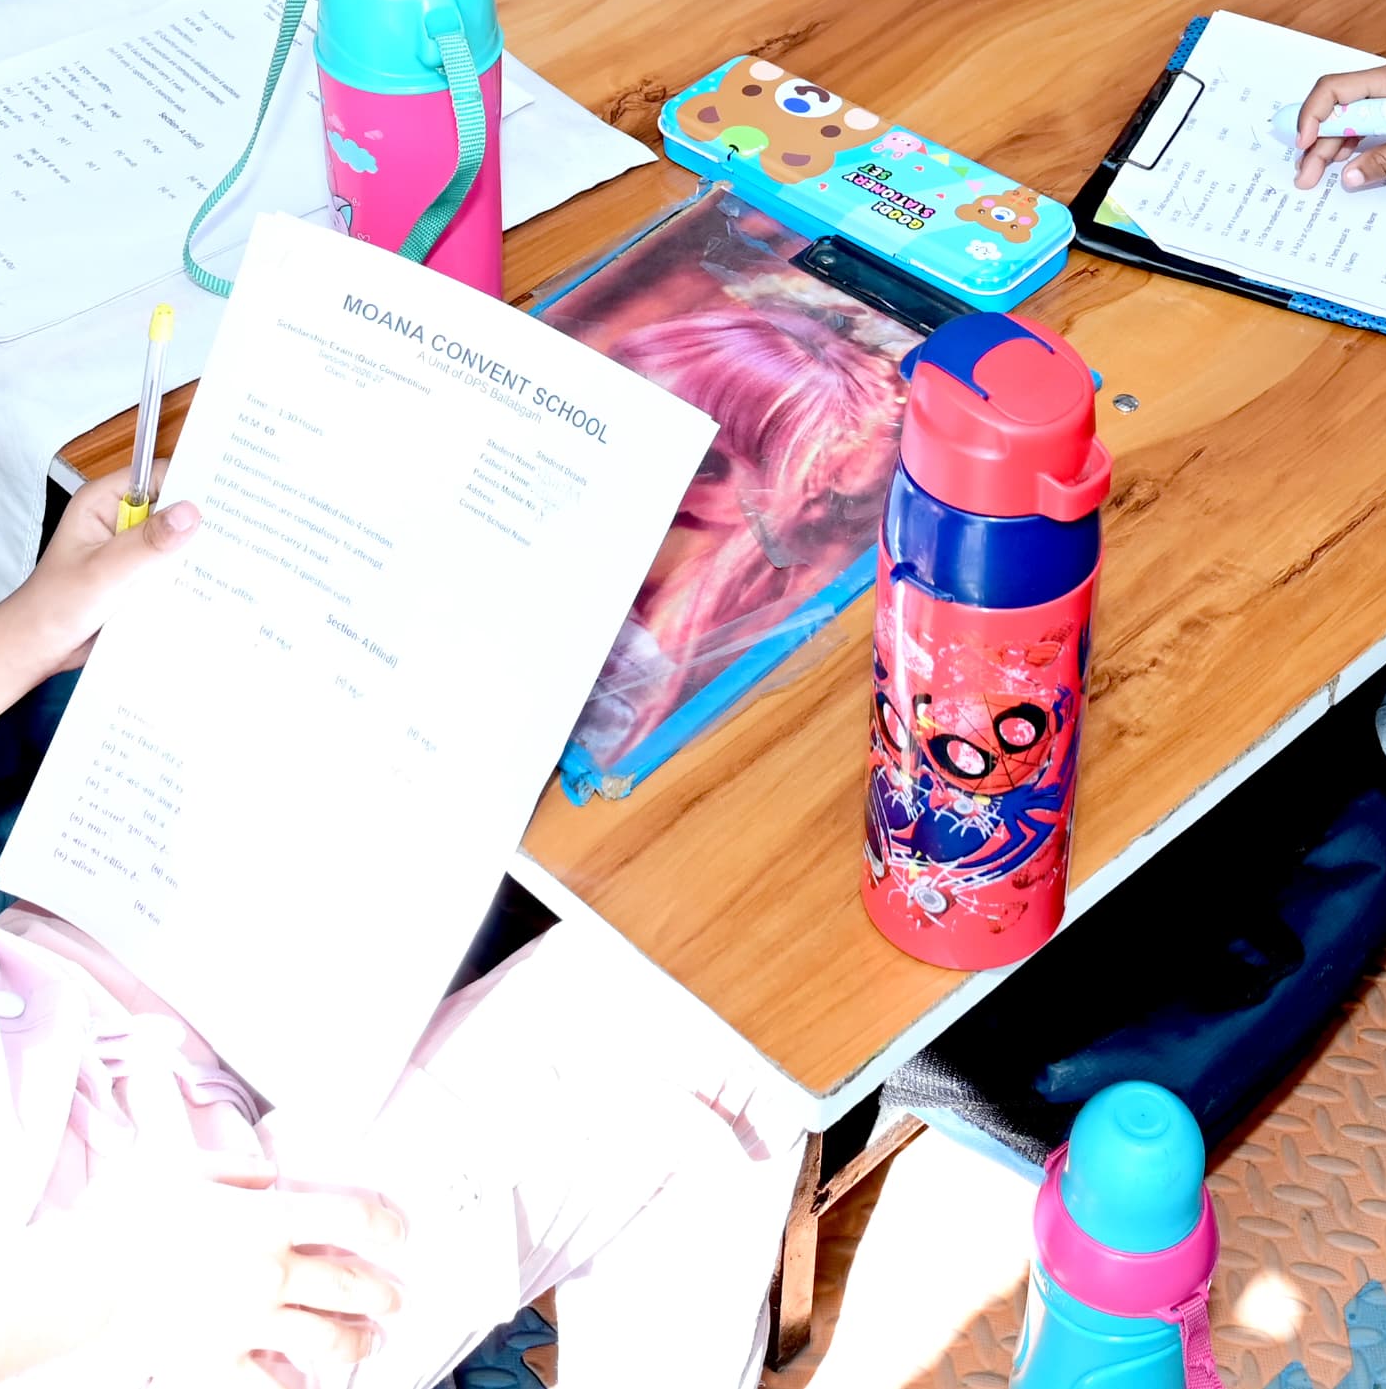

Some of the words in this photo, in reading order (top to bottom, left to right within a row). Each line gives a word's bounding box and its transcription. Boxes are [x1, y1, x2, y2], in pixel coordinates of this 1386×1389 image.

[857, 158, 892, 184] SET
[841, 165, 936, 222] STATIONERY
[870, 197, 924, 233] GOOD!
[342, 294, 424, 344] MOANA
[431, 334, 531, 395] CONVENT
[532, 387, 607, 444] SCHOOL
[415, 350, 426, 365] A
[427, 355, 451, 375] Unit
[450, 369, 465, 380] of
[463, 372, 490, 394] DPS
